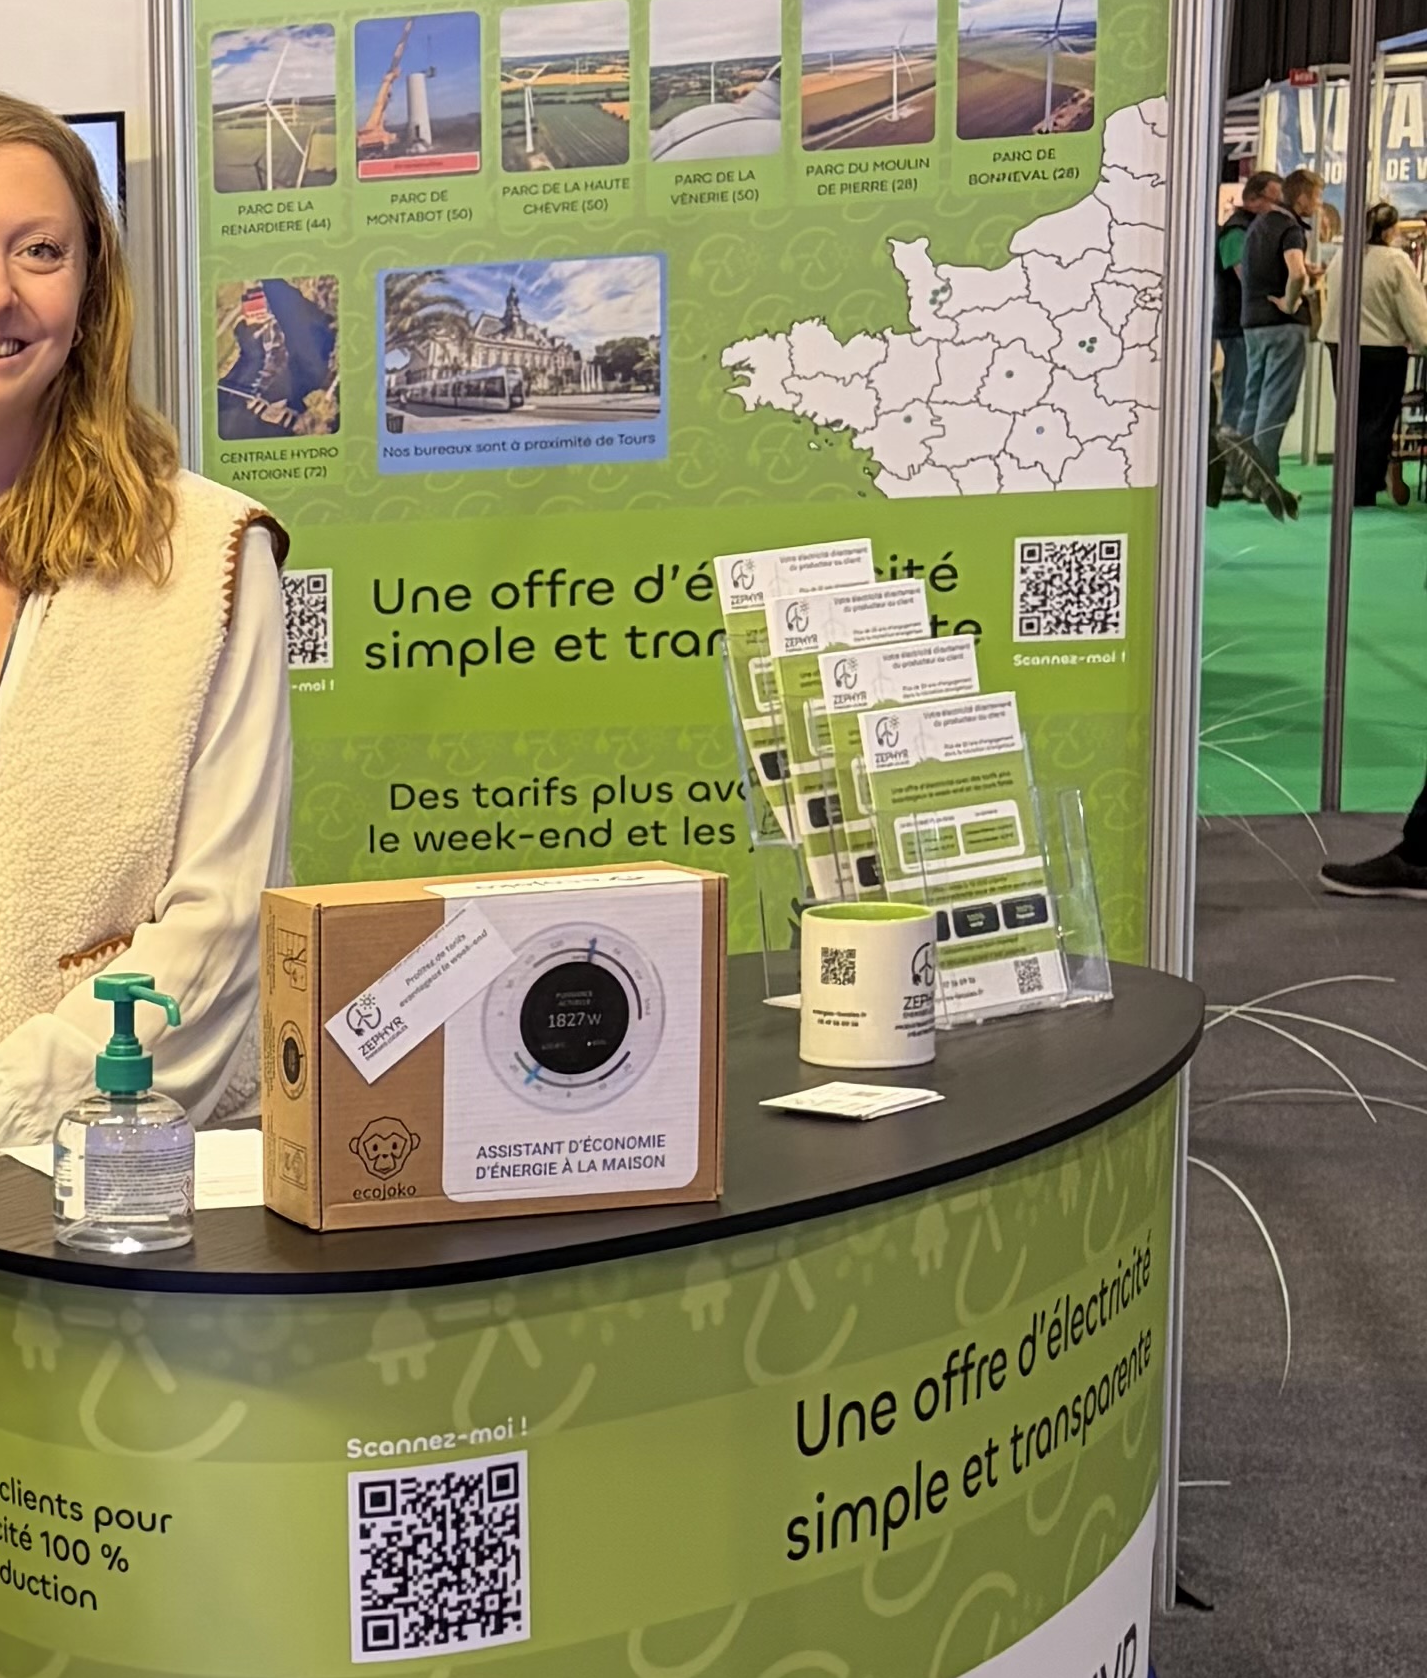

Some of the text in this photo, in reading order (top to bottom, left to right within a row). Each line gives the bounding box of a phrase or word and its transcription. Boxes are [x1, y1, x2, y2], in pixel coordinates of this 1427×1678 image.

[806, 157, 930, 176] PARC DU MOULIN
[817, 178, 918, 196] DE PIERRE (28)
[220, 447, 339, 464] CENTRALE HYDRO
[383, 433, 656, 458] Nos bureaux sont à proximité de Tours
[232, 465, 327, 481] ANTOIGNE (72)
[476, 1134, 666, 1160] ASSISTANT D'ÉCONOMIE
[476, 1155, 665, 1180] D'ÉNERGIE À LA MAISON
[353, 1183, 417, 1201] ecojoko
[796, 1229, 1152, 1457] Une offre d'électricité
[347, 1417, 513, 1459] Scannez-moi
[786, 1328, 1152, 1561] simple et transparente
[0, 1476, 173, 1534] clients pour
